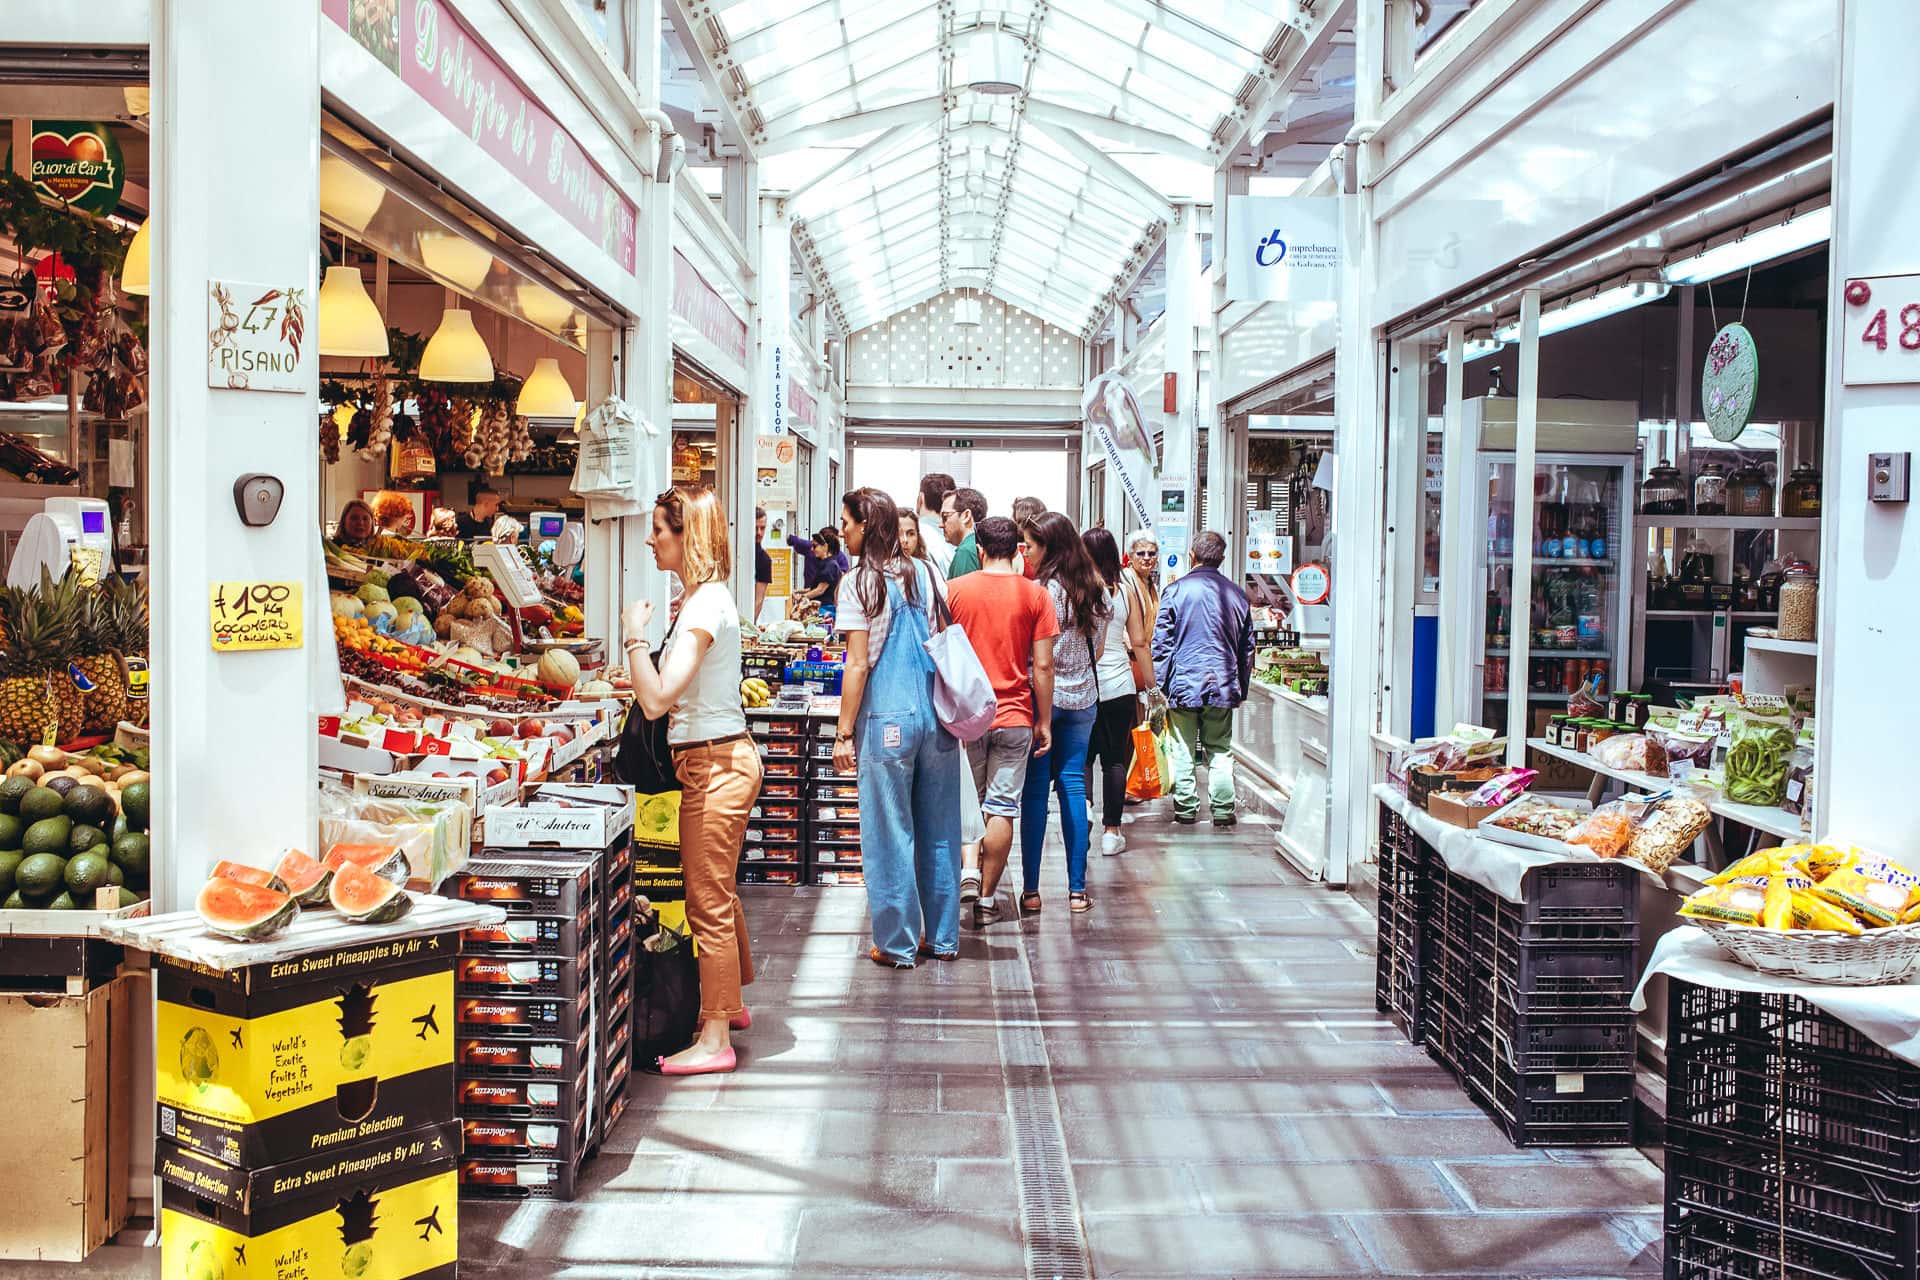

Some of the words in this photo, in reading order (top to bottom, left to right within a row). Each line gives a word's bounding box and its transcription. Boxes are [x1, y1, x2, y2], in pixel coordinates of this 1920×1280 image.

[621, 207, 634, 241] BOX
[242, 306, 278, 334] 47
[1861, 303, 1920, 351] 48
[221, 347, 295, 373] PISANO
[264, 603, 283, 617] KG
[213, 619, 289, 633] COCOMERO
[652, 878, 683, 887] Selection
[271, 959, 299, 978] Extra
[302, 955, 334, 973] Sweet
[335, 945, 389, 966] Pineapples
[392, 941, 405, 958] By
[405, 939, 422, 953] Air
[272, 1034, 307, 1053] World's
[275, 1053, 304, 1068] Exotic
[270, 1067, 297, 1085] Fruits
[264, 1081, 313, 1102] Vegetables
[311, 1124, 356, 1148] Premium
[358, 1114, 404, 1136] Selection
[162, 1160, 196, 1183] Premium
[195, 1171, 229, 1197] Selection
[274, 1176, 301, 1193] Extra
[304, 1168, 336, 1185] Sweet
[337, 1152, 391, 1174] Pineapples
[394, 1146, 408, 1162] By
[409, 1141, 425, 1157] Air
[274, 1247, 308, 1268] World's
